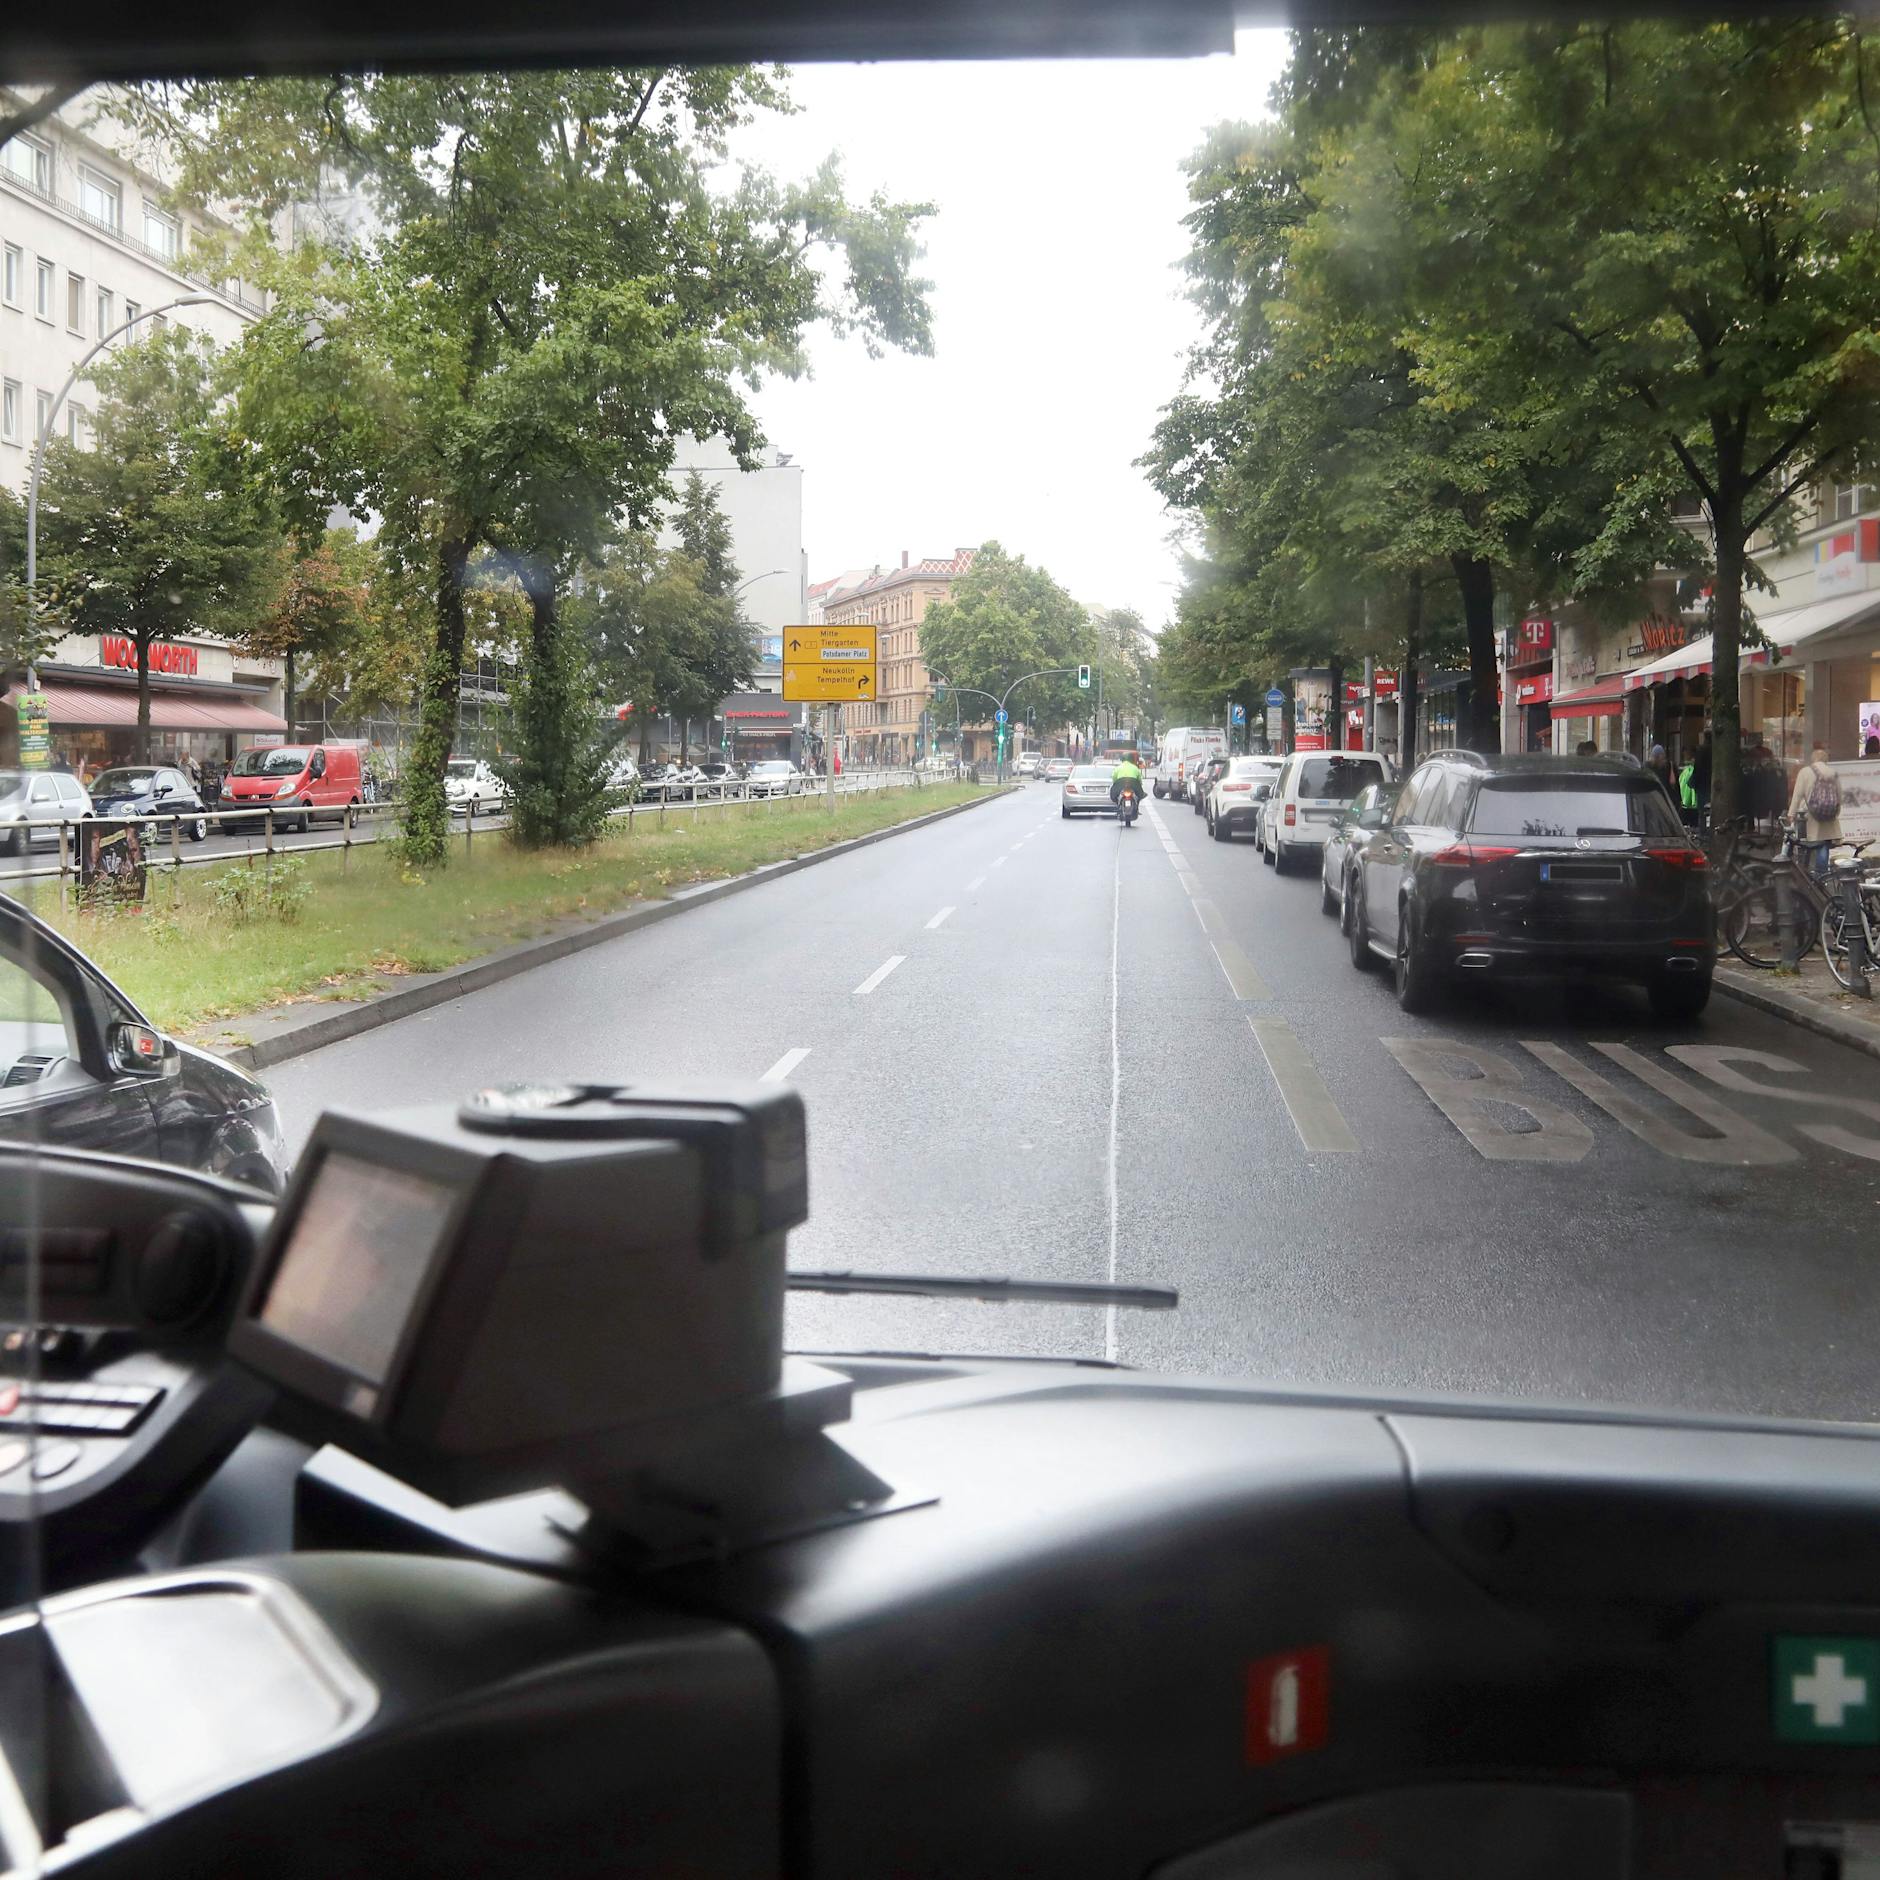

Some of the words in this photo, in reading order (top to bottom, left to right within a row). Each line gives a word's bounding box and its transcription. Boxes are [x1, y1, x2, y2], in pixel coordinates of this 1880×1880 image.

[1526, 622, 1545, 644] T
[102, 635, 197, 675] WOOWORTH
[817, 676, 855, 684] Tempelhof
[1378, 1037, 1880, 1164] BUS
